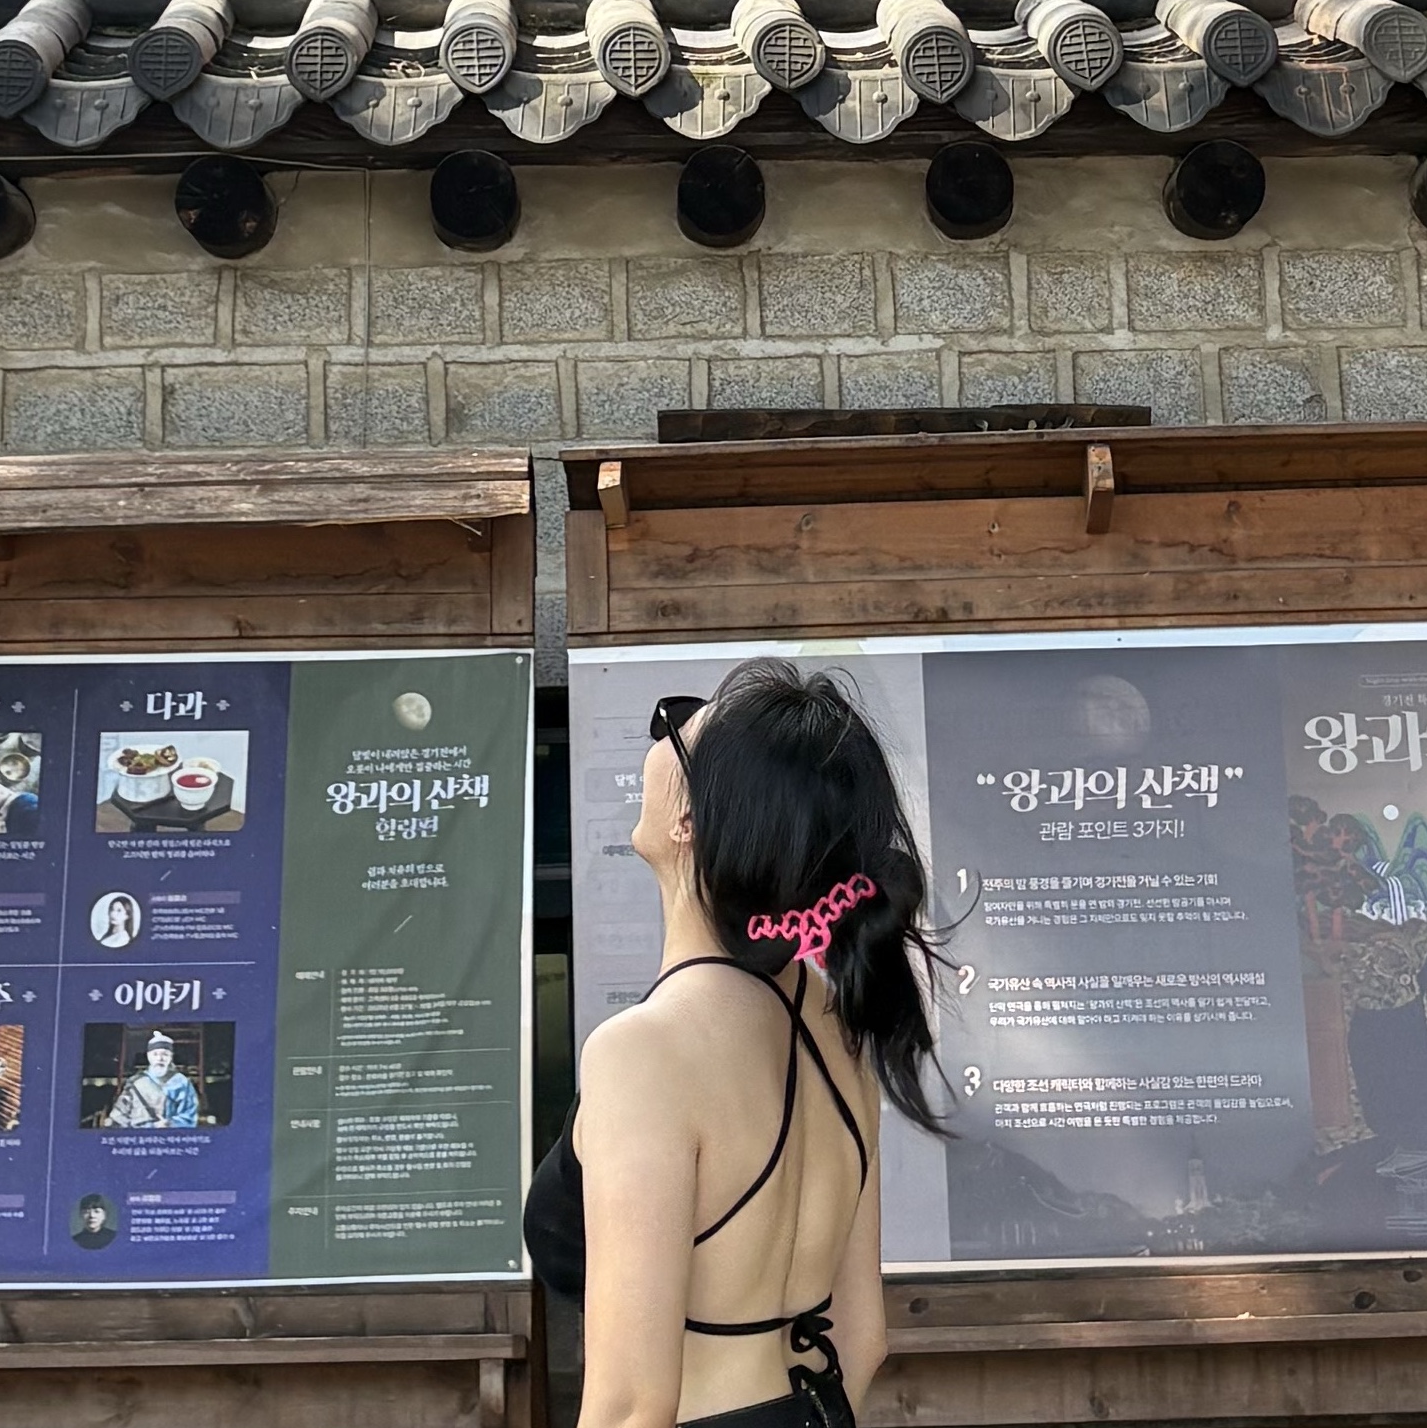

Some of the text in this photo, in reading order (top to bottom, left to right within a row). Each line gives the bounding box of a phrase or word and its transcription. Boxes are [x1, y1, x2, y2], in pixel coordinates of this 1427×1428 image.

[147, 692, 207, 719] 다과
[326, 774, 489, 814] 왕과의 산책
[376, 816, 438, 840] 힐링편
[1040, 820, 1184, 840] 관람 포인트 3가지!
[115, 981, 200, 1010] 이야기
